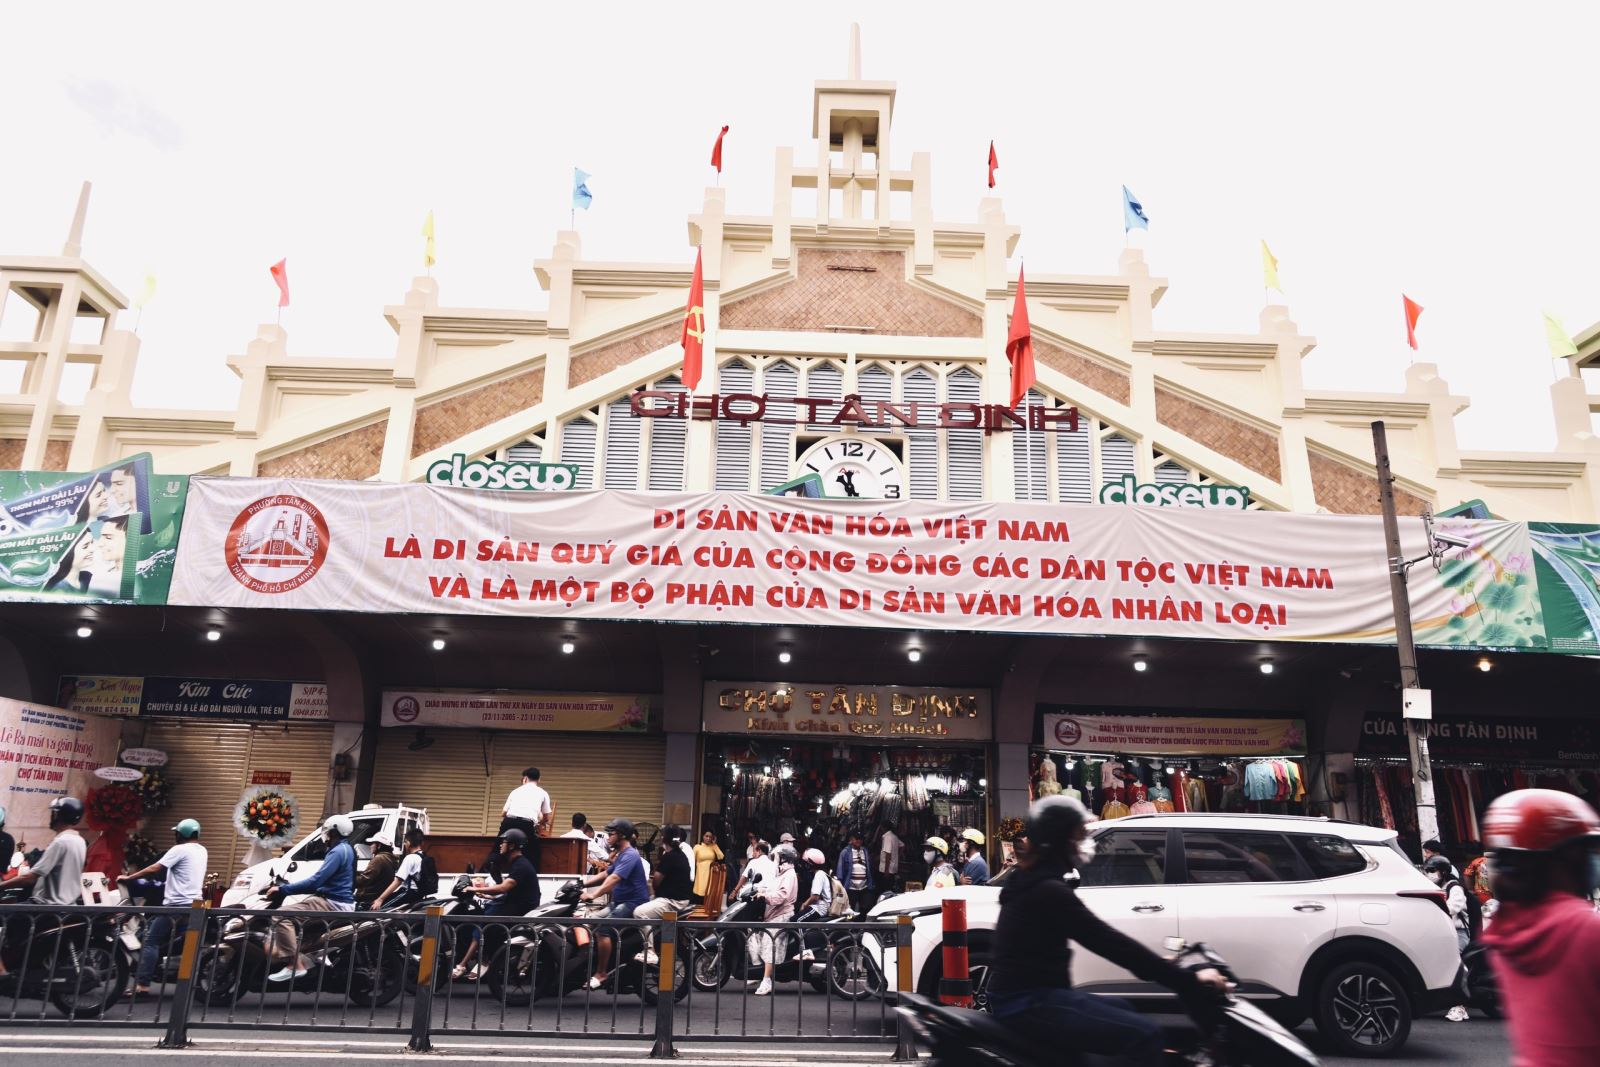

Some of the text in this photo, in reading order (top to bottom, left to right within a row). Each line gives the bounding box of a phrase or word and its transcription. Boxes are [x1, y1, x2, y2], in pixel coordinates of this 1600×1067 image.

[630, 390, 1079, 437] CHỢ TÂN ĐỊNH
[840, 442, 863, 457] 12
[428, 454, 574, 491] closeup
[884, 484, 900, 499] 3
[1101, 476, 1245, 510] closeup
[285, 496, 301, 507] TÂN
[653, 503, 1070, 545] DI SẢN VĂN HÓA VIỆT NAM
[384, 533, 1334, 591] LÀ DI SẢN QUÝ GIÁ CỦA CỘNG ĐỒNG CÁC DÂN TỘC VIỆT NAM
[299, 566, 317, 585] MINH
[428, 572, 1288, 631] VÀ LÀ MỘT BỘ PHẬN CỦA DI SẢN VĂN HÓA NHÂN LOẠI
[178, 681, 253, 699] Kim Cúc
[146, 702, 174, 711] CHUYÊN
[183, 704, 188, 712] &
[210, 703, 220, 712] DÀI
[273, 706, 284, 715] EM
[538, 702, 545, 710] DI
[599, 703, 614, 711] NAM
[719, 687, 795, 718] CHỢ
[805, 686, 879, 717] TÂN
[1364, 717, 1398, 736] CỬA
[1456, 721, 1491, 739] TÂN
[1495, 724, 1538, 743] ĐỊNH
[0, 749, 14, 763] HẬN
[16, 752, 23, 763] DI
[24, 752, 38, 764] TÍCH
[38, 753, 52, 766] KIẾN
[54, 756, 69, 768] TRÚC
[18, 766, 64, 783] CHỢ TÂN ĐỊNH
